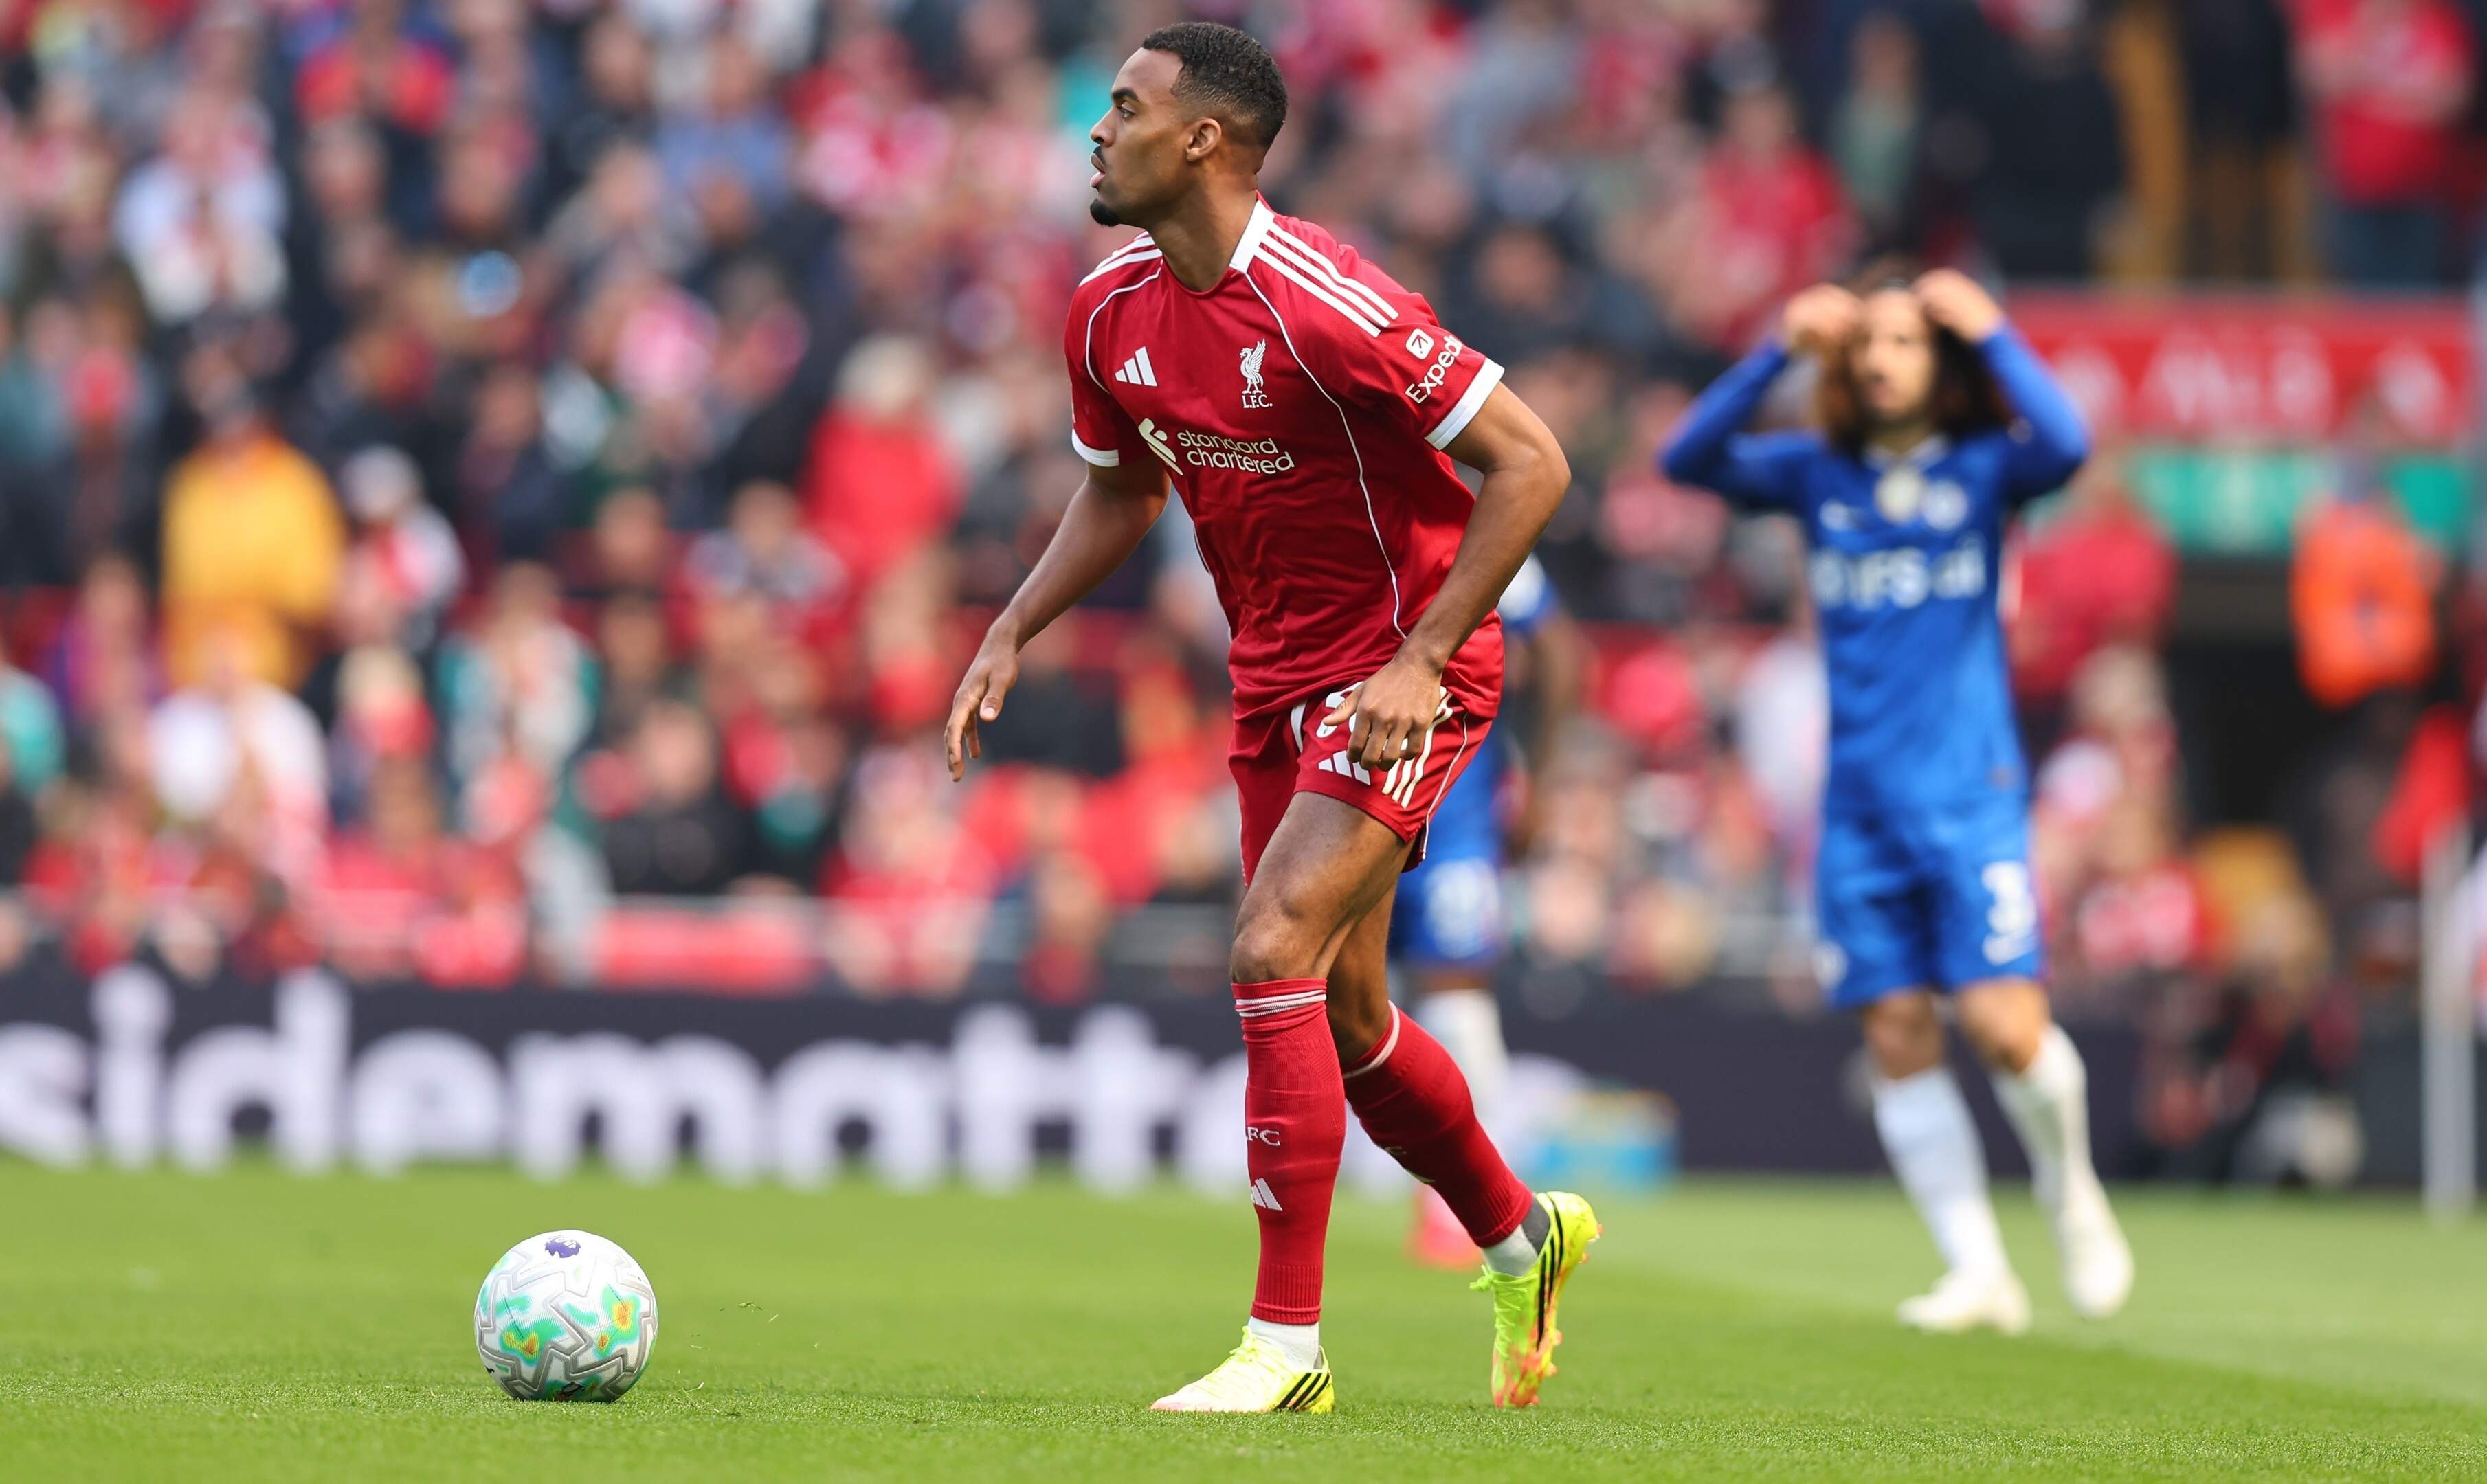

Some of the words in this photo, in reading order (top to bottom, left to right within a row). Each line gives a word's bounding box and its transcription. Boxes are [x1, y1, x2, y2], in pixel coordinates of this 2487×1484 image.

[1241, 394, 1273, 409] L.F.C.
[1176, 429, 1279, 455] standard
[1187, 447, 1295, 475] chartered
[1245, 1126, 1281, 1147] FC
